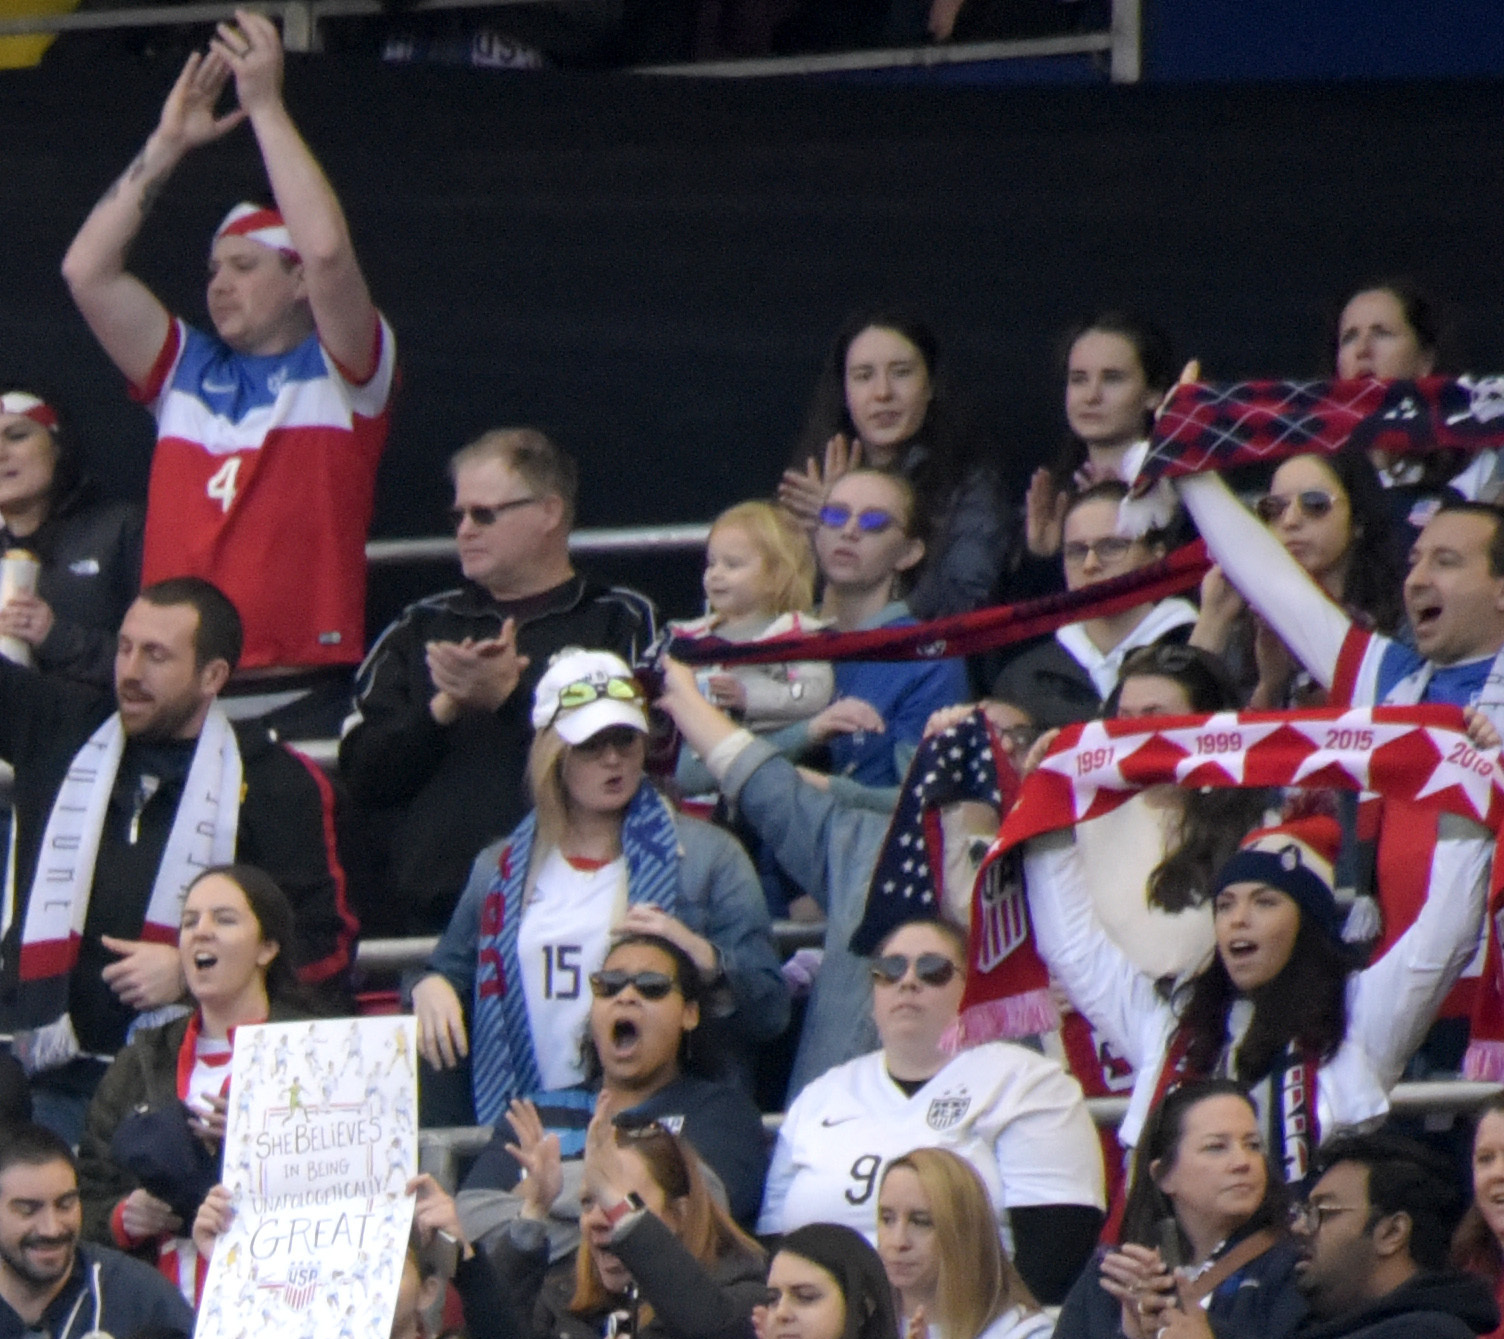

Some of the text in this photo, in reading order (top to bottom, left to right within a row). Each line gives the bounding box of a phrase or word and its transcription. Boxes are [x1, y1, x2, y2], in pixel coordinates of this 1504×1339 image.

[206, 456, 241, 514] 4
[1075, 748, 1114, 776] 1991
[1194, 733, 1242, 756] 1999
[1325, 730, 1374, 756] 2015
[542, 944, 581, 1001] 15
[249, 1212, 376, 1262] GREAT
